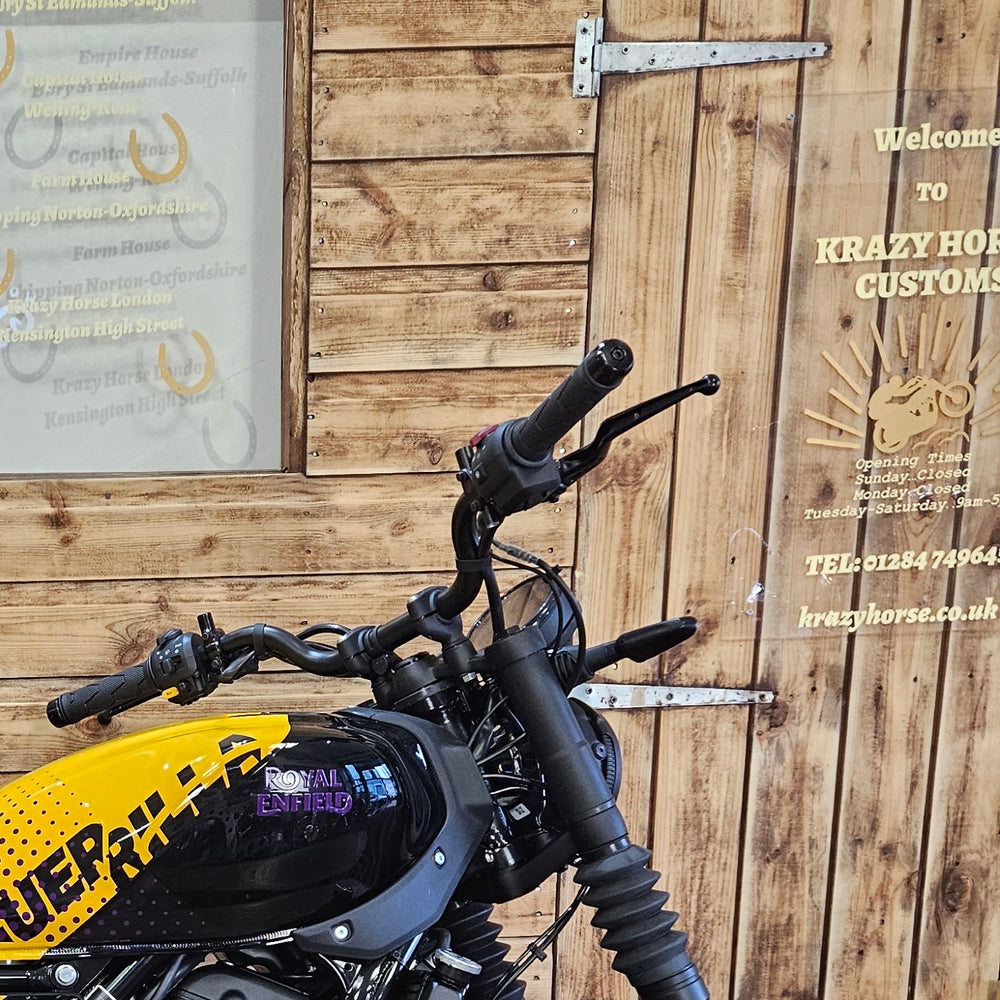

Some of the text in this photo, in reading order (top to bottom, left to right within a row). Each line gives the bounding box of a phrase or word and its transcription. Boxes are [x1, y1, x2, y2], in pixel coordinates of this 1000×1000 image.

[873, 123, 1000, 152] Welcome
[916, 182, 948, 201] TO
[815, 232, 935, 264] KRAZY
[855, 452, 973, 472] Opening Times
[798, 597, 999, 633] krazyhorse.co.uk
[265, 766, 342, 792] ROYAL
[256, 791, 353, 817] ENFIELD
